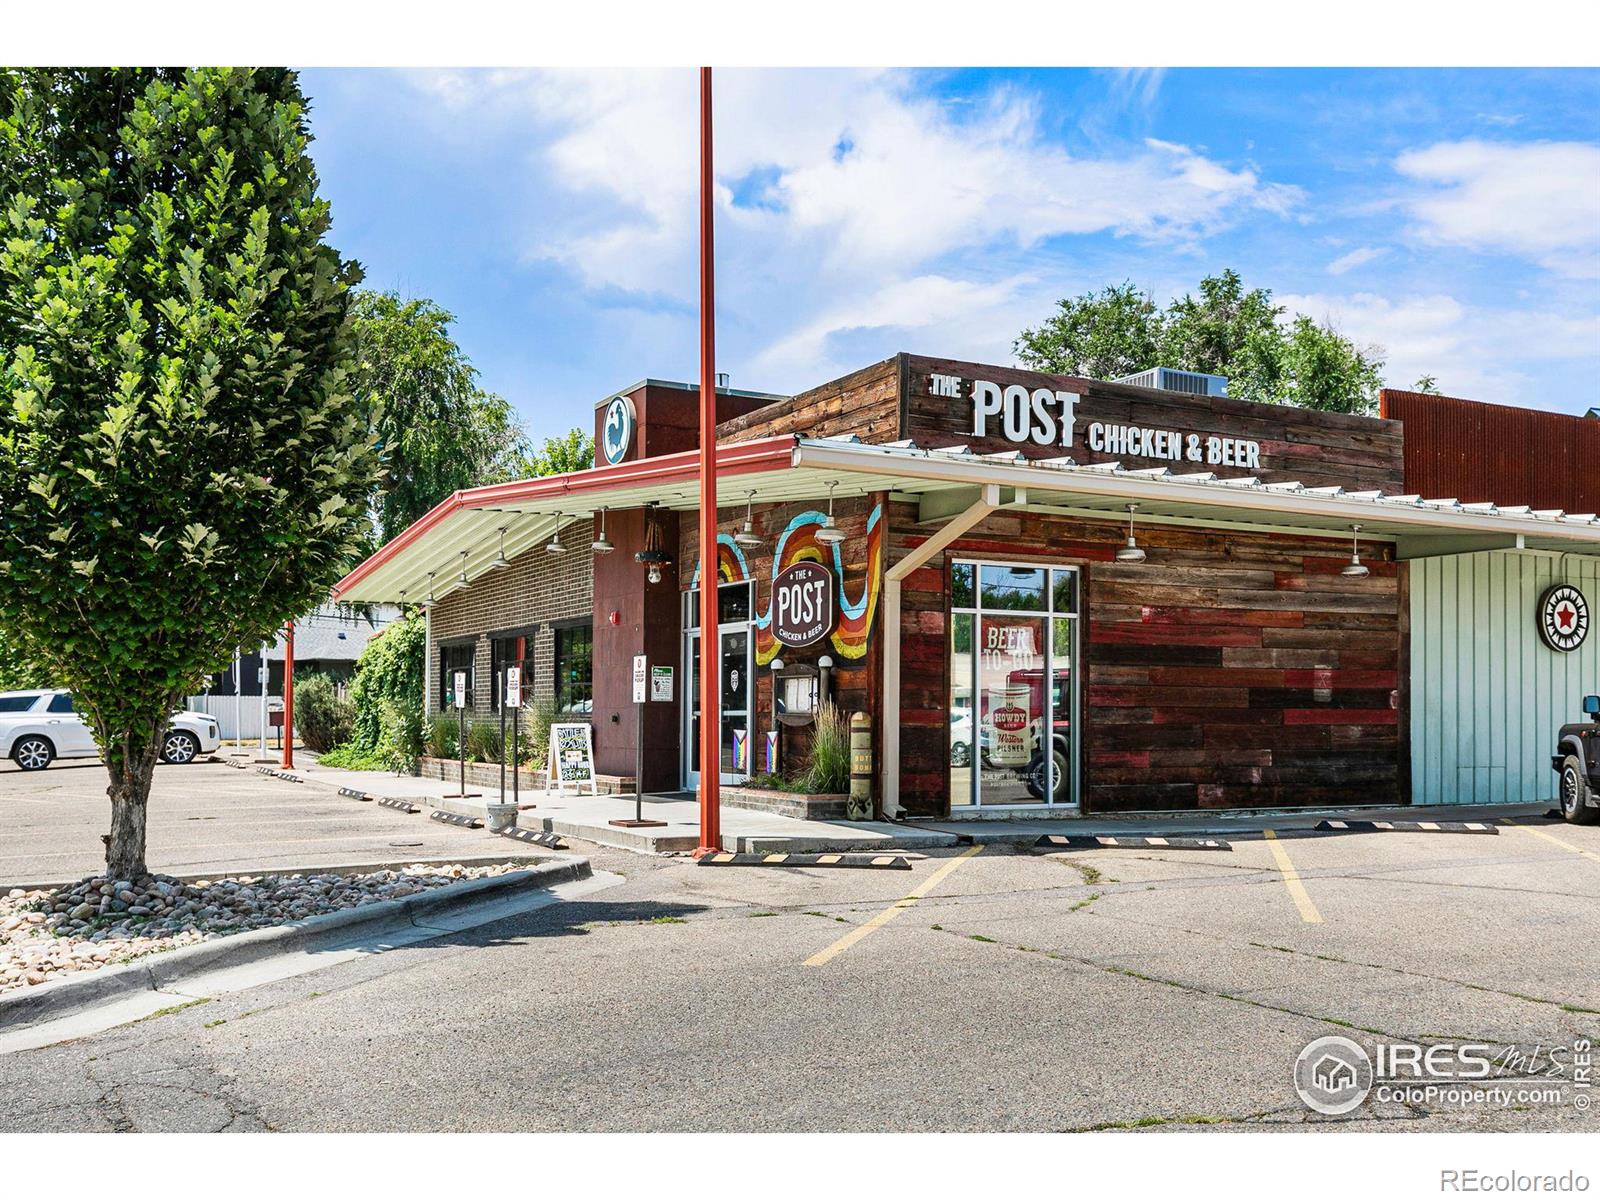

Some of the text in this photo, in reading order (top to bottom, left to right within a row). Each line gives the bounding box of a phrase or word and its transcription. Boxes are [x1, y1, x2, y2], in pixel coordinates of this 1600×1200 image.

[929, 373, 962, 398] THE
[969, 380, 1081, 447] POST
[1089, 422, 1260, 469] CHICKEN & BEER
[795, 569, 807, 580] THE
[778, 580, 825, 626] POST
[778, 628, 802, 641] CHICKEN
[808, 623, 823, 638] BEER
[987, 626, 1026, 650] BEER
[994, 713, 1026, 722] HOWDY
[997, 744, 1025, 753] PILSNER
